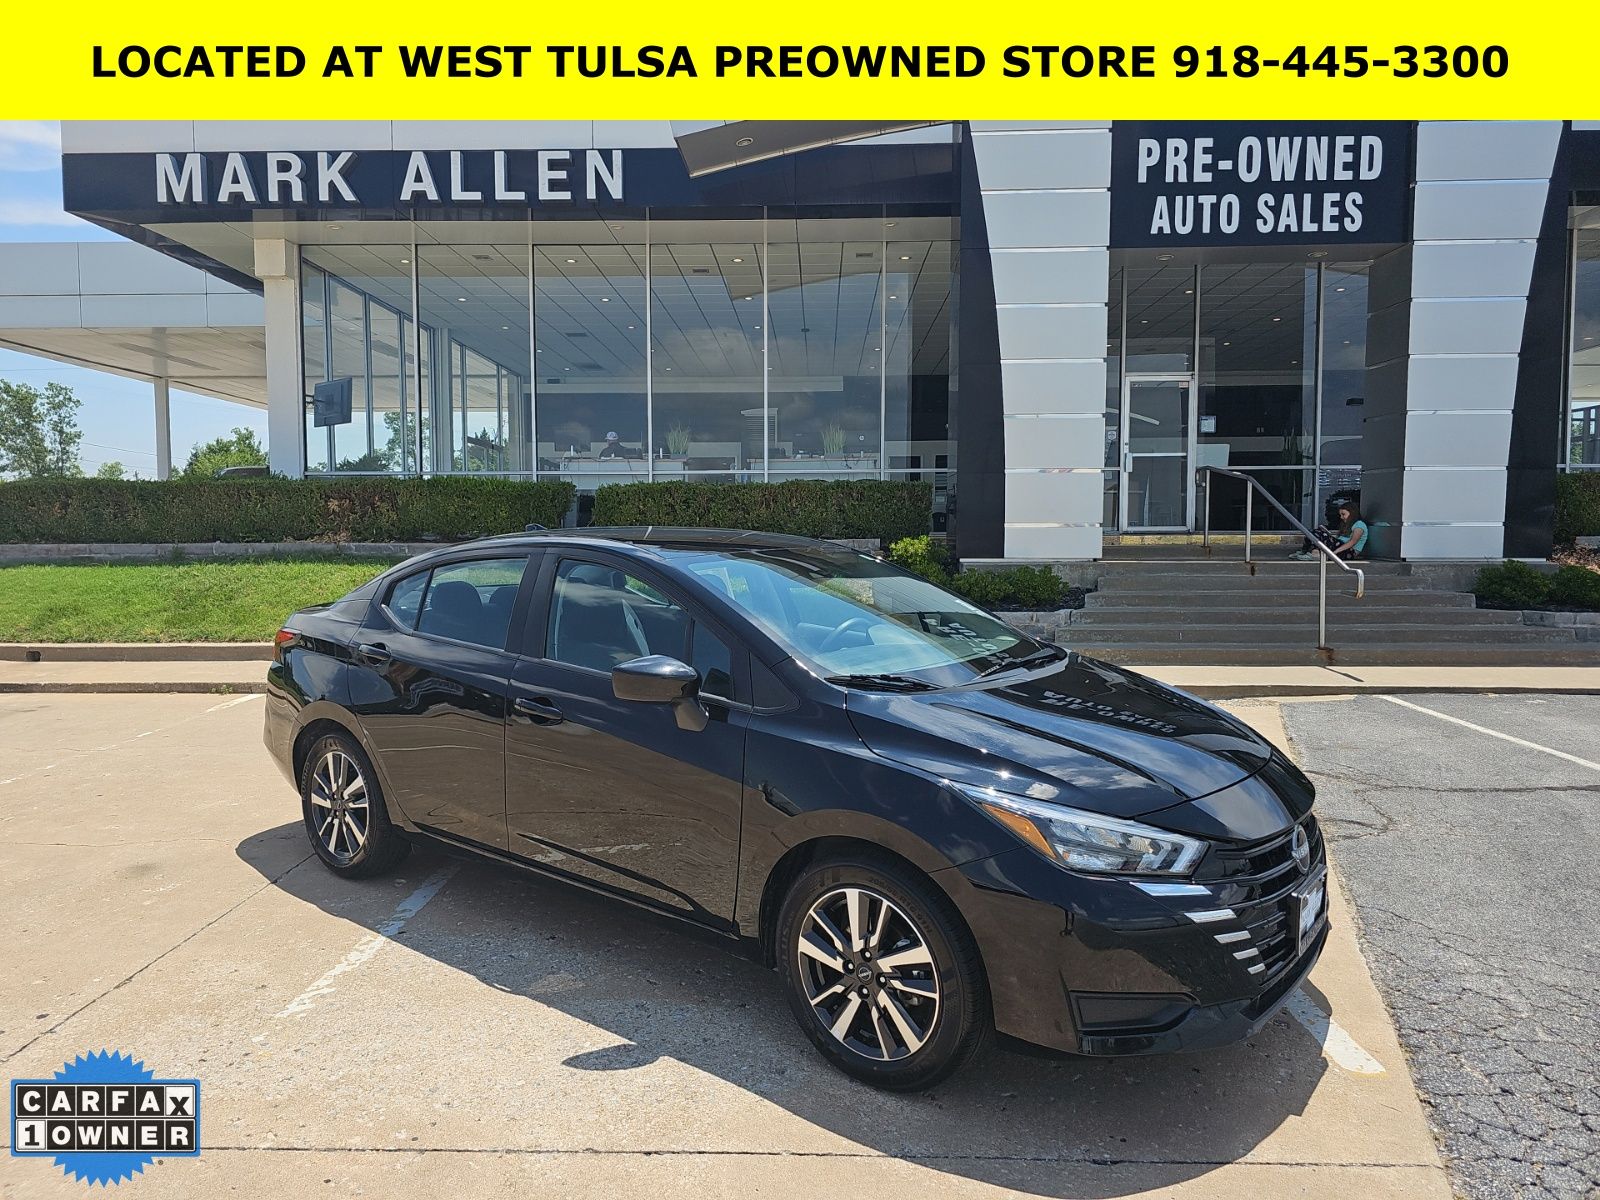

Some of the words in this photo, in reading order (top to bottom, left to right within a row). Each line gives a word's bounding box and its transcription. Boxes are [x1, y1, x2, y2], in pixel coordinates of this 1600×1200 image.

[155, 151, 357, 203] MARK
[400, 149, 623, 201] ALLEN
[1138, 135, 1383, 183] PRE-OWNED
[1150, 194, 1240, 235] AUTO
[1256, 192, 1363, 234] SALES
